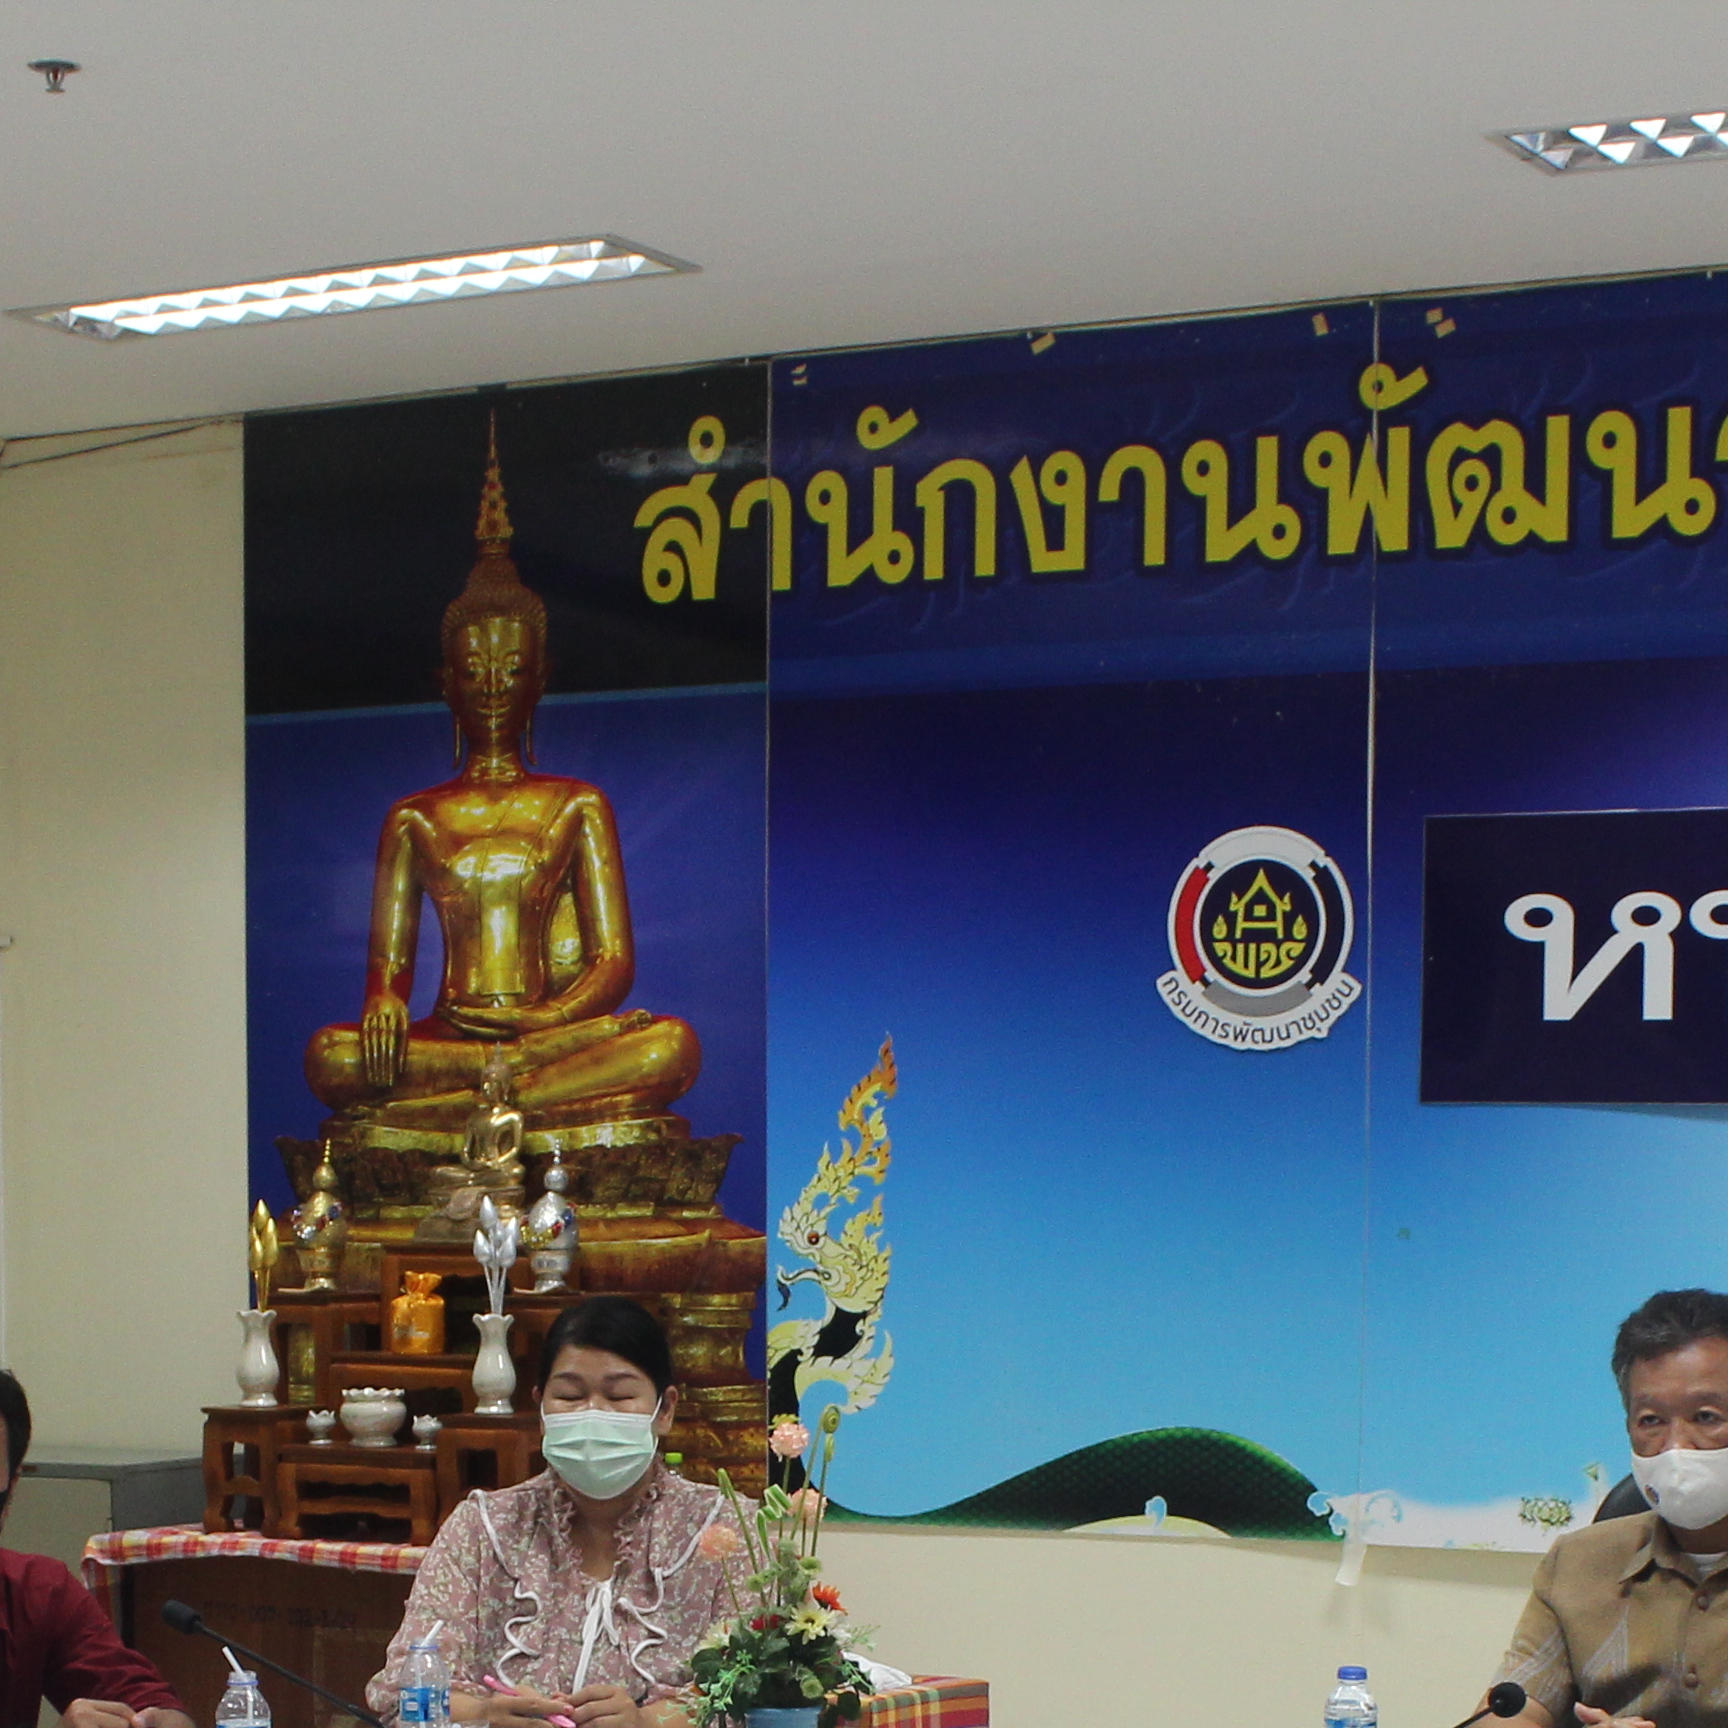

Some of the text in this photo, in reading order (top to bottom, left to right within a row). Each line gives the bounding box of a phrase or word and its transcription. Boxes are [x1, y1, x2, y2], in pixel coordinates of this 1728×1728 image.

[1161, 977, 1355, 1044] กรมการพัฒนาชุมชน
